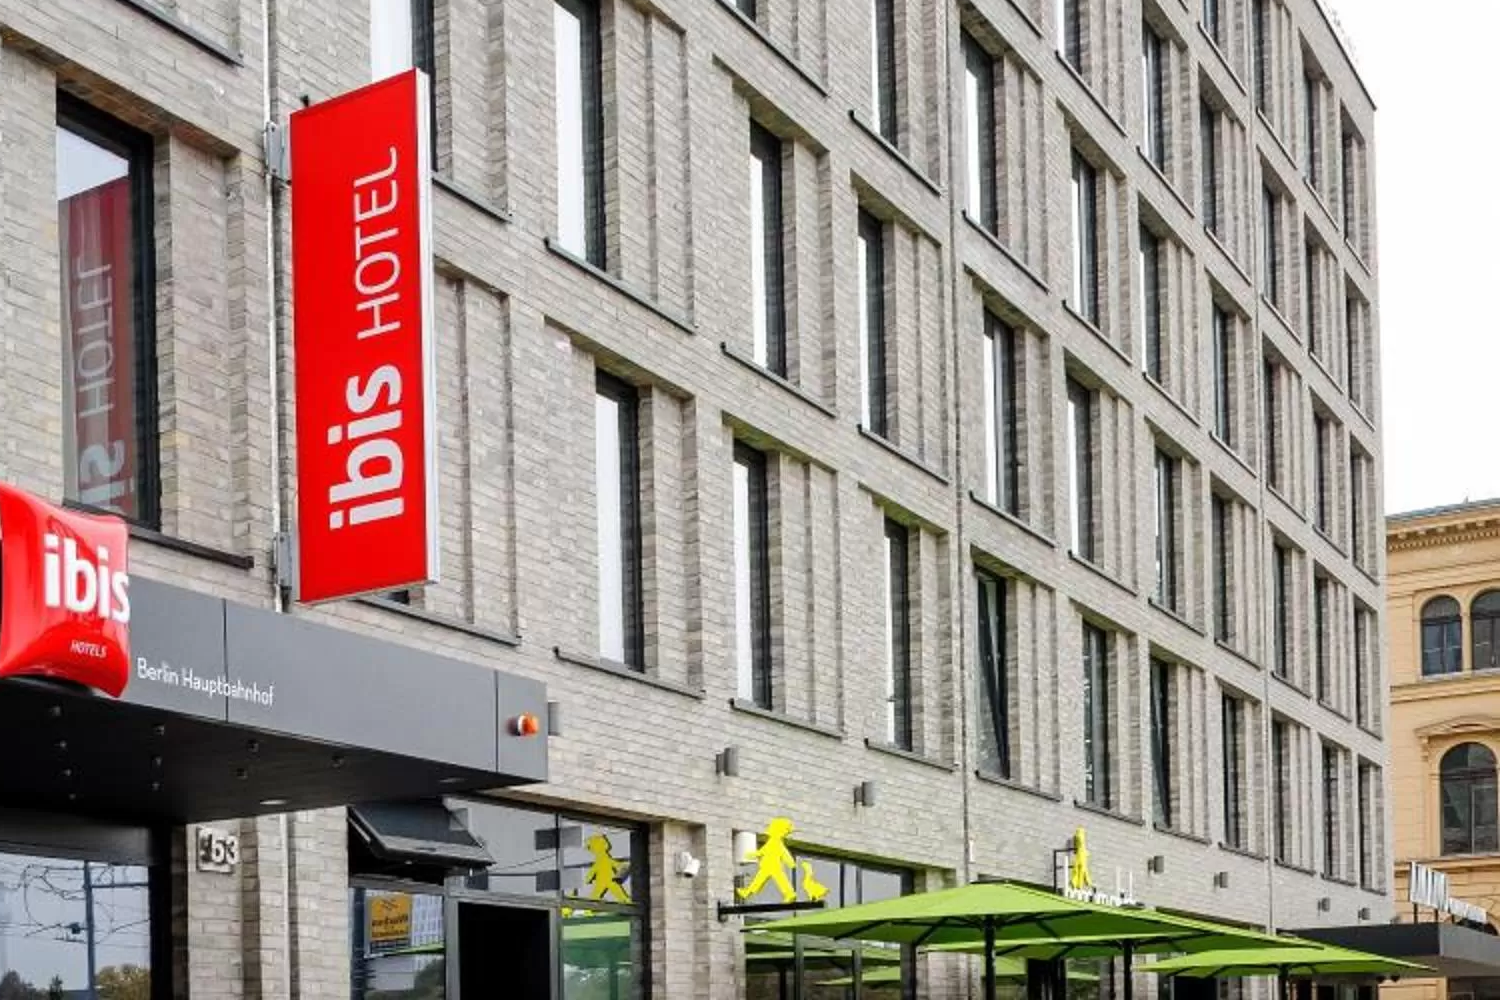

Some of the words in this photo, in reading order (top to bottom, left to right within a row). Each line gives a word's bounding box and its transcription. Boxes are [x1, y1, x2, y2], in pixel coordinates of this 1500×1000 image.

[353, 145, 402, 340] HOTEL
[327, 363, 404, 530] ibis
[43, 533, 130, 624] ibis
[69, 639, 107, 659] HOTELS
[137, 656, 179, 686] Berlin
[182, 667, 276, 707] Hauptbahnhof
